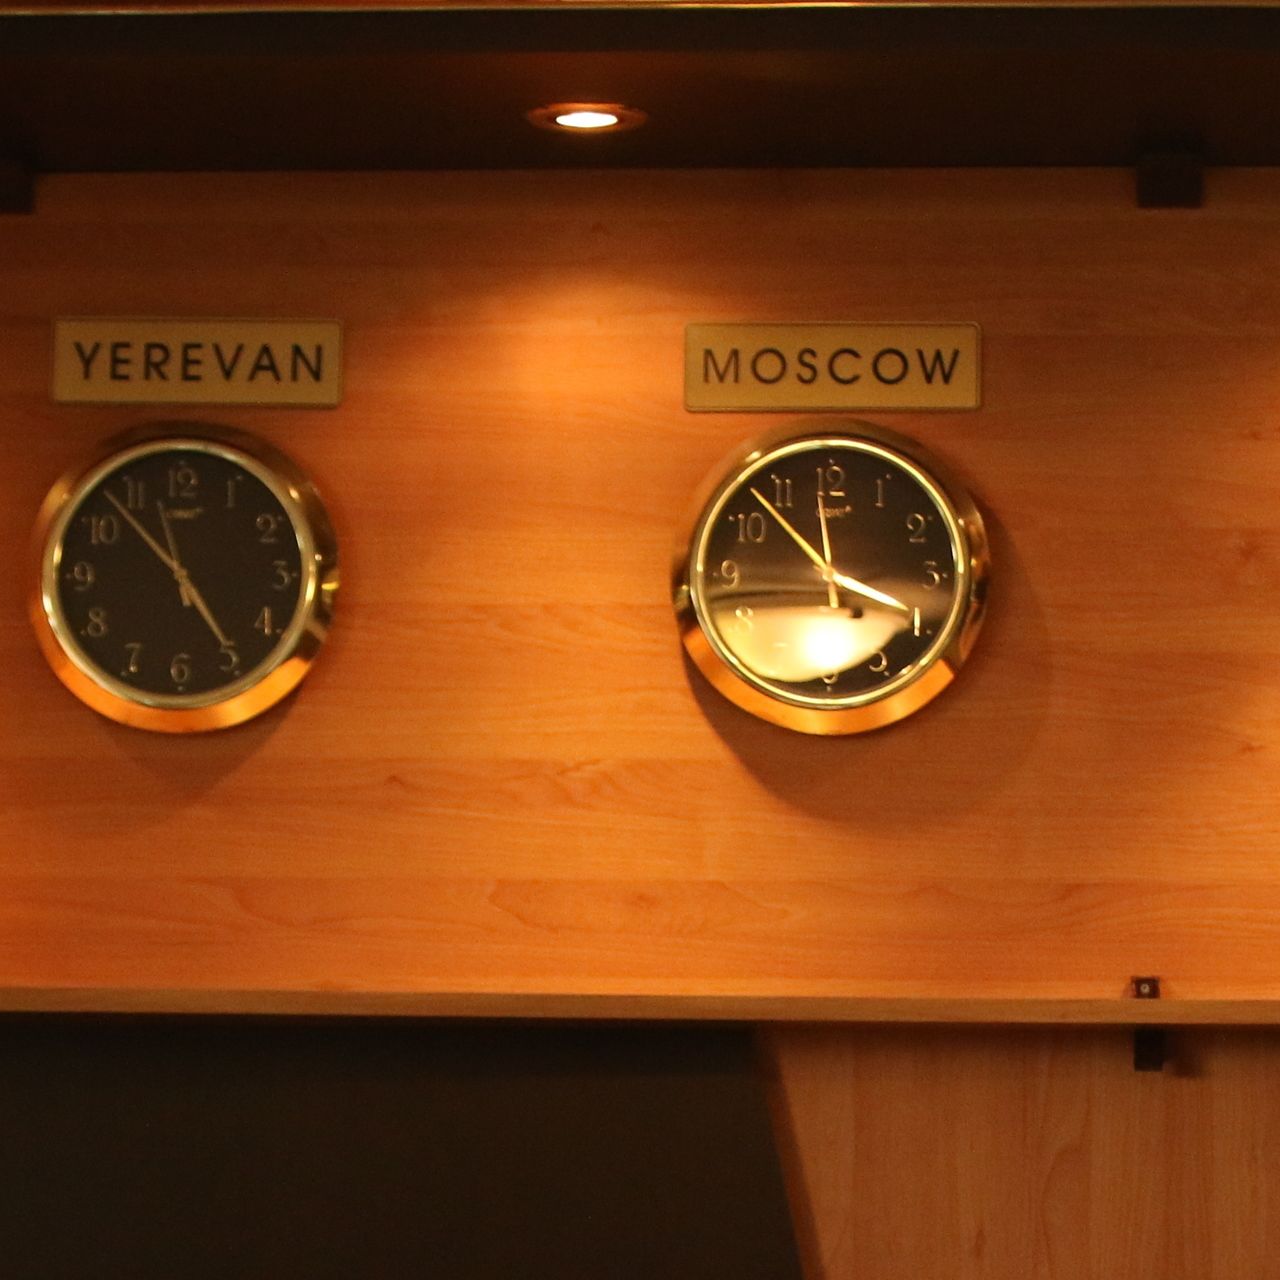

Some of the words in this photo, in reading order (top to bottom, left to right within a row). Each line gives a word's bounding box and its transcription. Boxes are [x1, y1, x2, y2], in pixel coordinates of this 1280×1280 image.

[74, 341, 323, 383] YEREVAN
[703, 348, 961, 386] MOSCOW
[127, 480, 146, 509] 11
[168, 470, 199, 498] 12
[226, 479, 236, 507] 1
[773, 477, 793, 507] 11
[816, 466, 846, 496] 12
[875, 479, 884, 507] 1
[88, 516, 118, 543] 10
[256, 515, 277, 542] 2
[737, 513, 766, 543] 10
[907, 513, 926, 542] 2
[73, 562, 95, 590] 9
[272, 562, 289, 589] 3
[720, 560, 738, 588] 9
[923, 562, 939, 590] 3
[88, 610, 108, 636] 8
[254, 609, 272, 636] 4
[124, 643, 143, 672] 7
[171, 653, 187, 682] 6
[219, 642, 239, 671] 5
